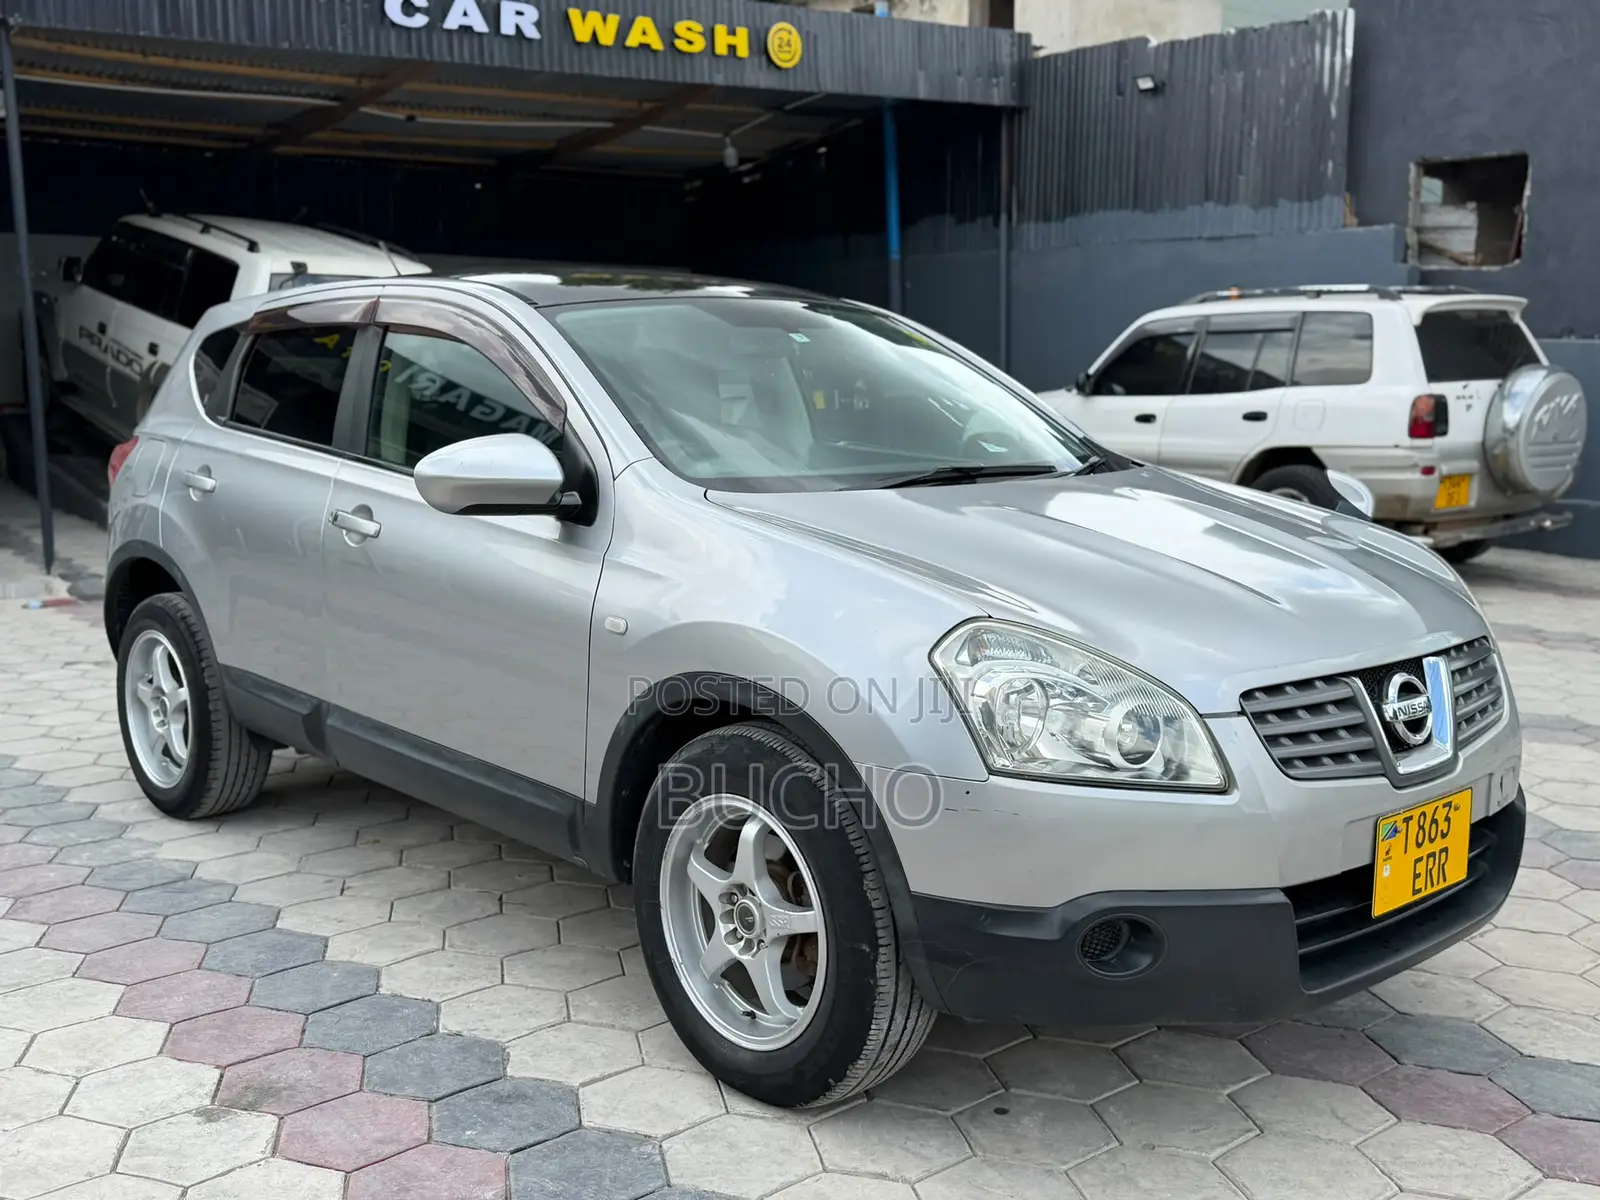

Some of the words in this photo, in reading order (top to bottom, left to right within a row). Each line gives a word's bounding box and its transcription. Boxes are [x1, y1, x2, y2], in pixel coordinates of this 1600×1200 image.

[384, 0, 541, 40] CAR
[568, 8, 749, 58] WASH
[1402, 800, 1453, 855] T863
[1412, 846, 1449, 896] ERR
